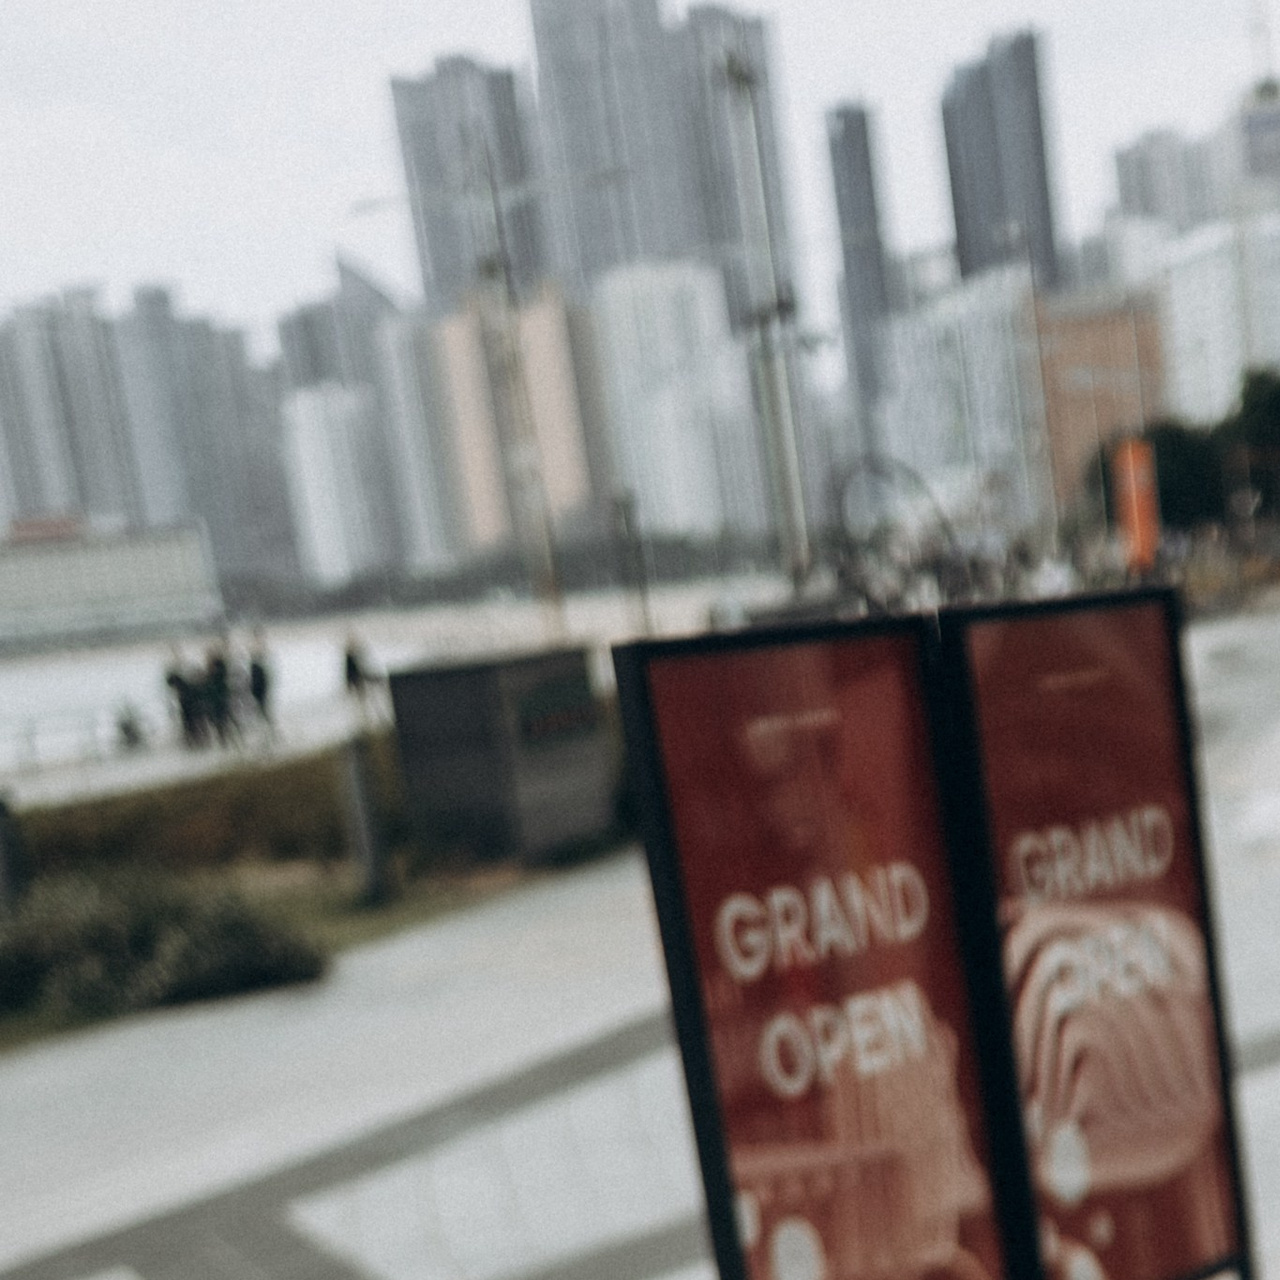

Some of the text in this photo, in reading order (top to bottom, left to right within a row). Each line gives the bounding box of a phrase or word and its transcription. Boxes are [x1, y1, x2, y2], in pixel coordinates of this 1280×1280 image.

[1013, 806, 1174, 903] GRAND
[715, 862, 930, 983] GRAND
[759, 980, 926, 1096] OPEN
